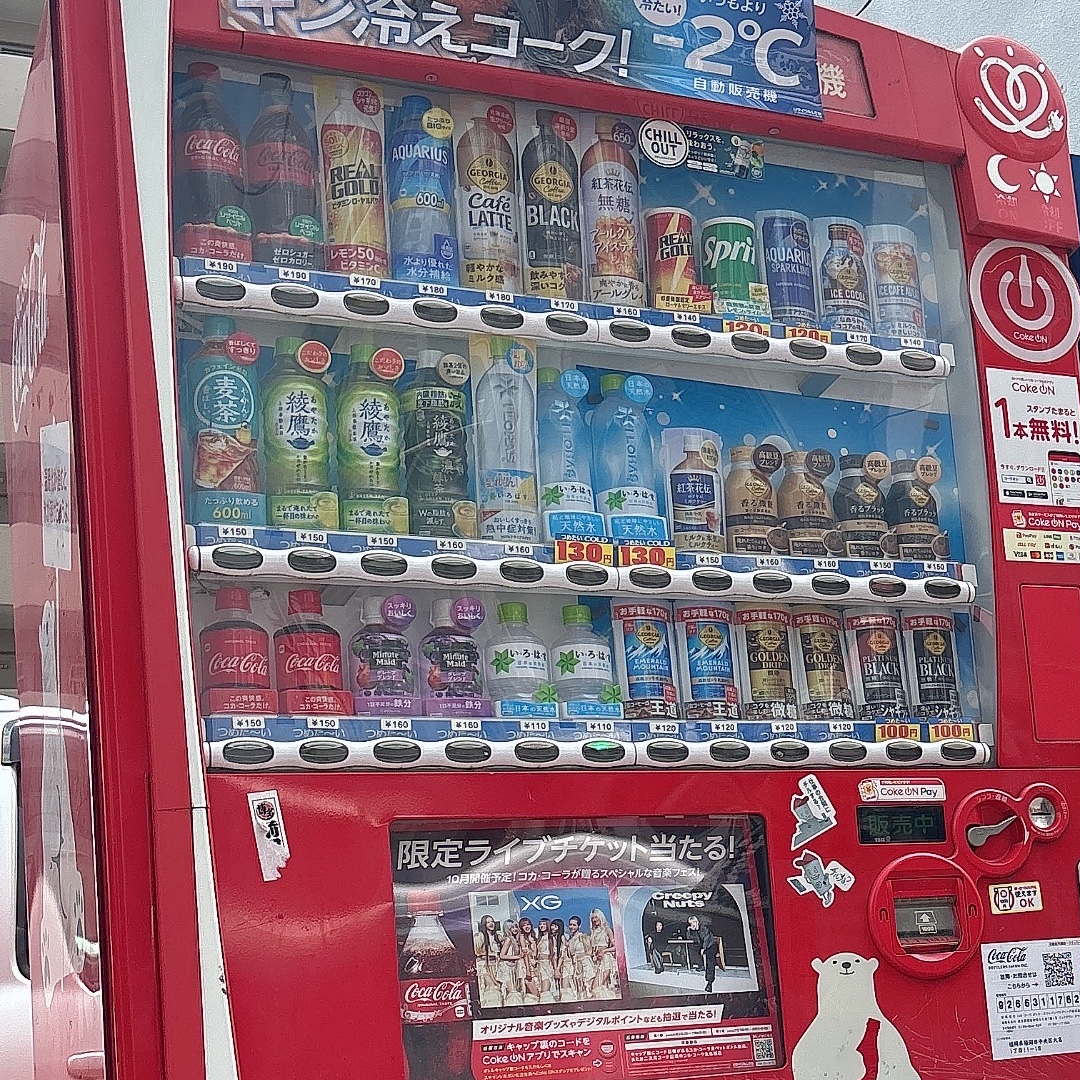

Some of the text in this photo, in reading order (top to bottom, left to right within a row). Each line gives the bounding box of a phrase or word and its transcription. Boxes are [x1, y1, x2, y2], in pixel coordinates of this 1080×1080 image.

[693, 76, 779, 104] 自動販売機
[645, 128, 683, 148] CHILL
[391, 144, 449, 165] AQUARIUS
[651, 141, 677, 158] OUT
[330, 158, 379, 184] REAL
[469, 168, 509, 181] GEORGIA
[534, 176, 571, 189] GEORGIA
[331, 181, 381, 201] GOLD
[468, 193, 510, 212] Café
[469, 210, 513, 232] LATTE
[527, 205, 580, 232] BLACK
[208, 260, 234, 272] ¥190
[282, 270, 307, 280] ¥190
[406, 268, 451, 281] 水分補給
[353, 276, 377, 286] ¥170
[422, 284, 445, 294] ¥180
[488, 292, 511, 302] ¥180
[553, 301, 575, 310] ¥170
[616, 307, 638, 316] ¥160
[676, 313, 697, 322] ¥140
[850, 334, 868, 342] ¥170
[903, 338, 921, 346] ¥140
[1012, 382, 1038, 394] Coke
[213, 376, 240, 422] 麦茶
[285, 390, 311, 437] 綾鷹
[1026, 405, 1076, 417] スタンプたまると
[359, 397, 384, 444] 綾鷹
[676, 482, 712, 494] 紅茶花伝
[222, 528, 247, 536] ¥150
[561, 521, 597, 533] 天然水
[622, 525, 658, 536] 天然水
[300, 533, 324, 542] ¥150
[371, 537, 395, 546] ¥150
[584, 535, 608, 543] COLD
[440, 541, 464, 549] ¥160
[508, 545, 530, 554] ¥160
[557, 541, 612, 564] 130円
[621, 546, 675, 567] 130円
[699, 556, 720, 564] ¥150
[372, 650, 400, 660] Minute
[443, 653, 469, 661] Minute
[750, 652, 789, 662] GOLDEN
[209, 651, 269, 676] Coca-Cola
[285, 652, 340, 674] Coca-Cola
[375, 658, 396, 667] Maid
[445, 660, 466, 668] Maid
[864, 662, 899, 676] BLACK
[920, 663, 954, 677] BLACK
[650, 701, 677, 718] 王道
[714, 702, 739, 718] 王道
[771, 702, 797, 718] 微糖
[236, 719, 262, 727] ¥150
[311, 719, 336, 727] ¥150
[385, 720, 409, 729] ¥160
[455, 721, 479, 730] ¥160
[523, 721, 547, 731] ¥110
[590, 722, 612, 731] ¥110
[655, 724, 676, 733] ¥120
[714, 723, 735, 731] ¥120
[774, 723, 795, 731] ¥120
[878, 725, 918, 737] 100円
[931, 724, 970, 737] 100円
[881, 788, 903, 796] Coke
[920, 788, 938, 797] Pay
[867, 814, 934, 836] 販売中
[397, 835, 735, 870] 限定ライブチケット当たる!
[652, 890, 713, 902] Creepy
[520, 895, 562, 912] XG
[663, 899, 705, 909] Nuts
[1020, 898, 1035, 908] OK
[988, 947, 1028, 964] Coca-Cola
[405, 980, 464, 1003] Coca-Cola
